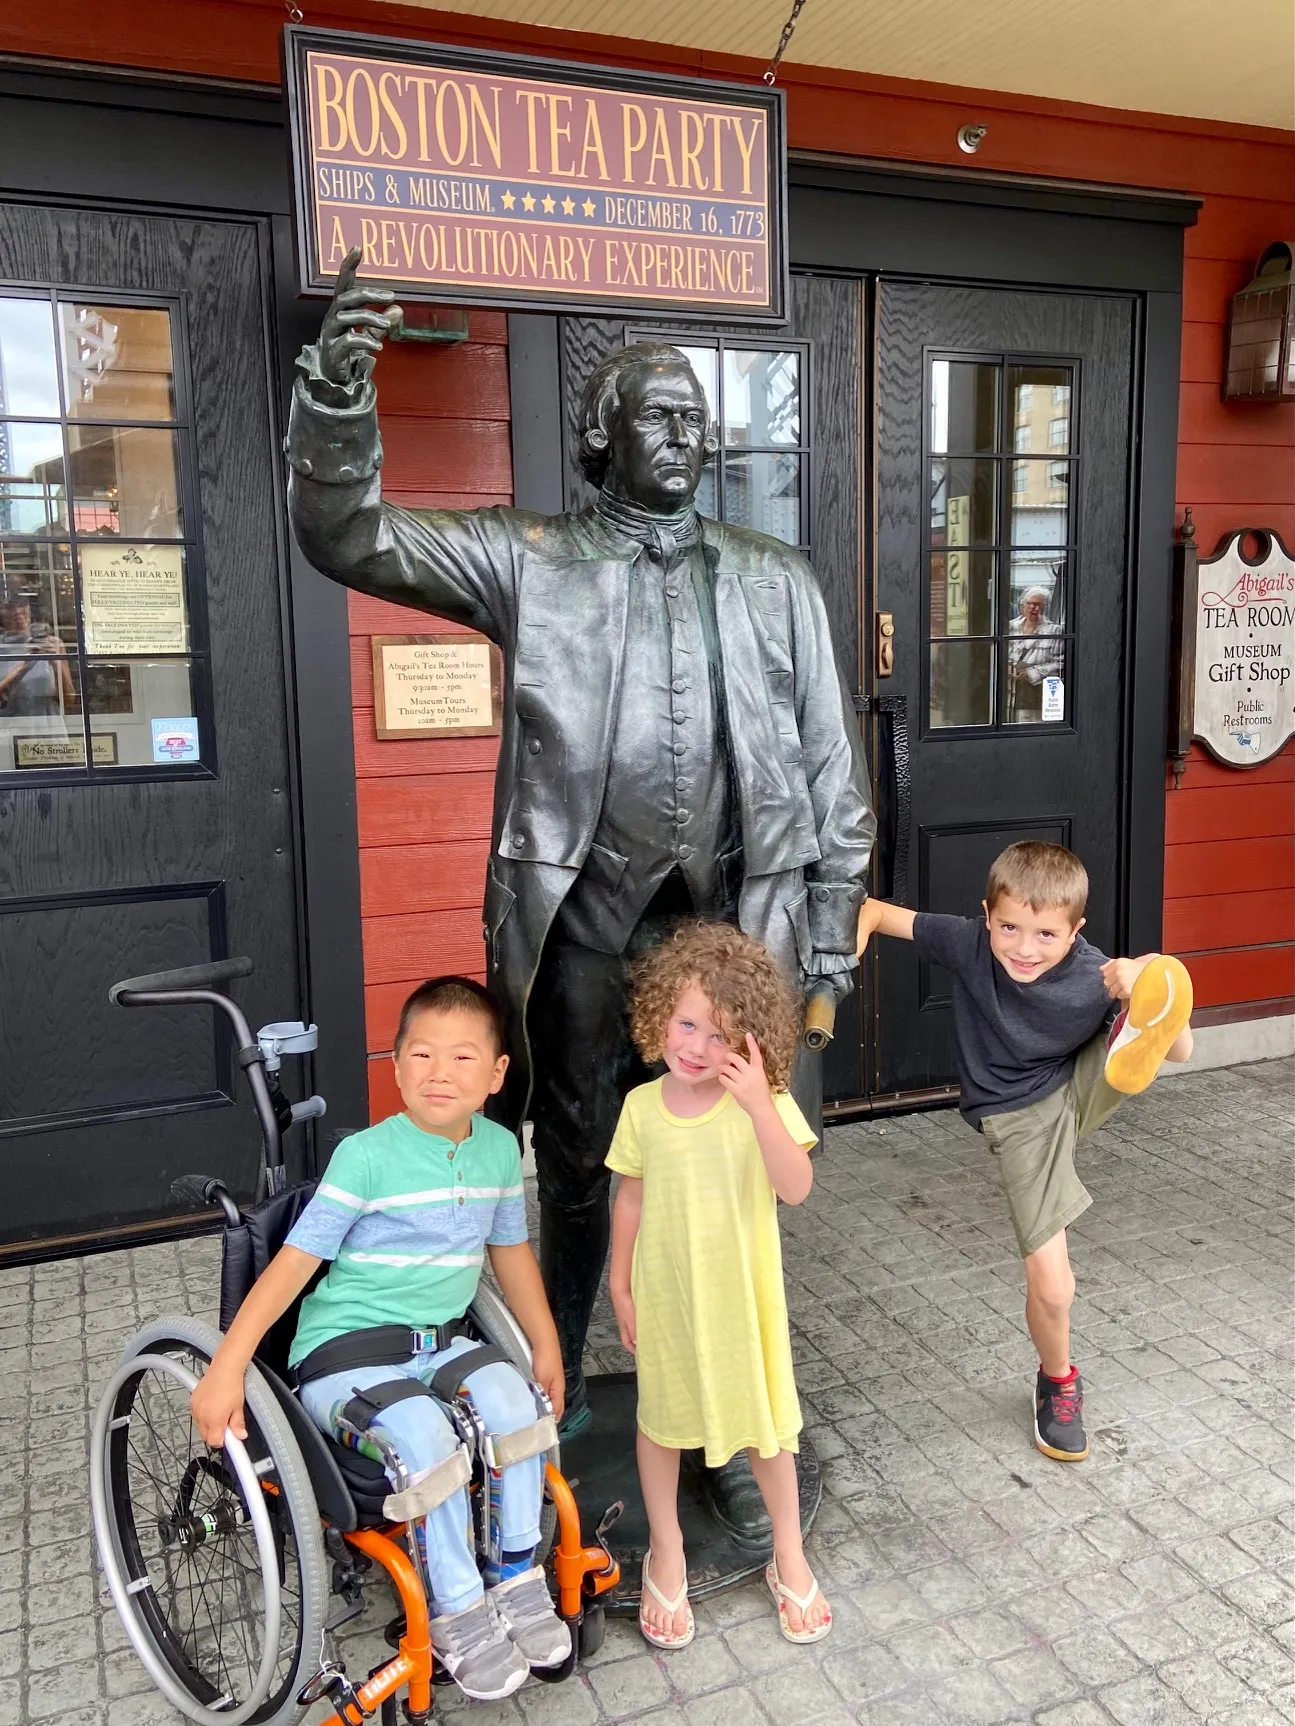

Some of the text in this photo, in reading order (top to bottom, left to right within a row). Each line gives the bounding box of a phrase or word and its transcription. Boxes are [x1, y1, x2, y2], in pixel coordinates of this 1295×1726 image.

[313, 64, 764, 195] BOSTON TEA PARTY
[319, 167, 376, 202] SHIPS
[385, 174, 400, 204] &
[604, 196, 693, 231] DECEMBER
[700, 206, 723, 236] 16,
[730, 210, 765, 237] 1773
[328, 215, 350, 264] A
[360, 217, 596, 283] REVOLUTIONARY
[604, 239, 756, 294] EXPERIENCE
[90, 570, 178, 579] HEAR YE, HEAR YE!
[1225, 572, 1295, 600] Abigail's
[1203, 606, 1295, 629] TEA ROOM
[413, 651, 429, 659] Gift
[430, 651, 450, 659] Shop
[1224, 644, 1282, 659] MUSEUM
[388, 661, 484, 671] Abigail's Tea Room Hours
[395, 672, 433, 682] Thursday
[445, 672, 478, 681] Monday
[1208, 661, 1291, 687] Gift Shop
[410, 696, 466, 706] Museum Tours
[1236, 700, 1265, 713] Public
[397, 706, 479, 716] Thursday to Monday
[1223, 714, 1273, 728] Restrooms
[32, 747, 45, 755] No
[47, 747, 79, 755] Strollers
